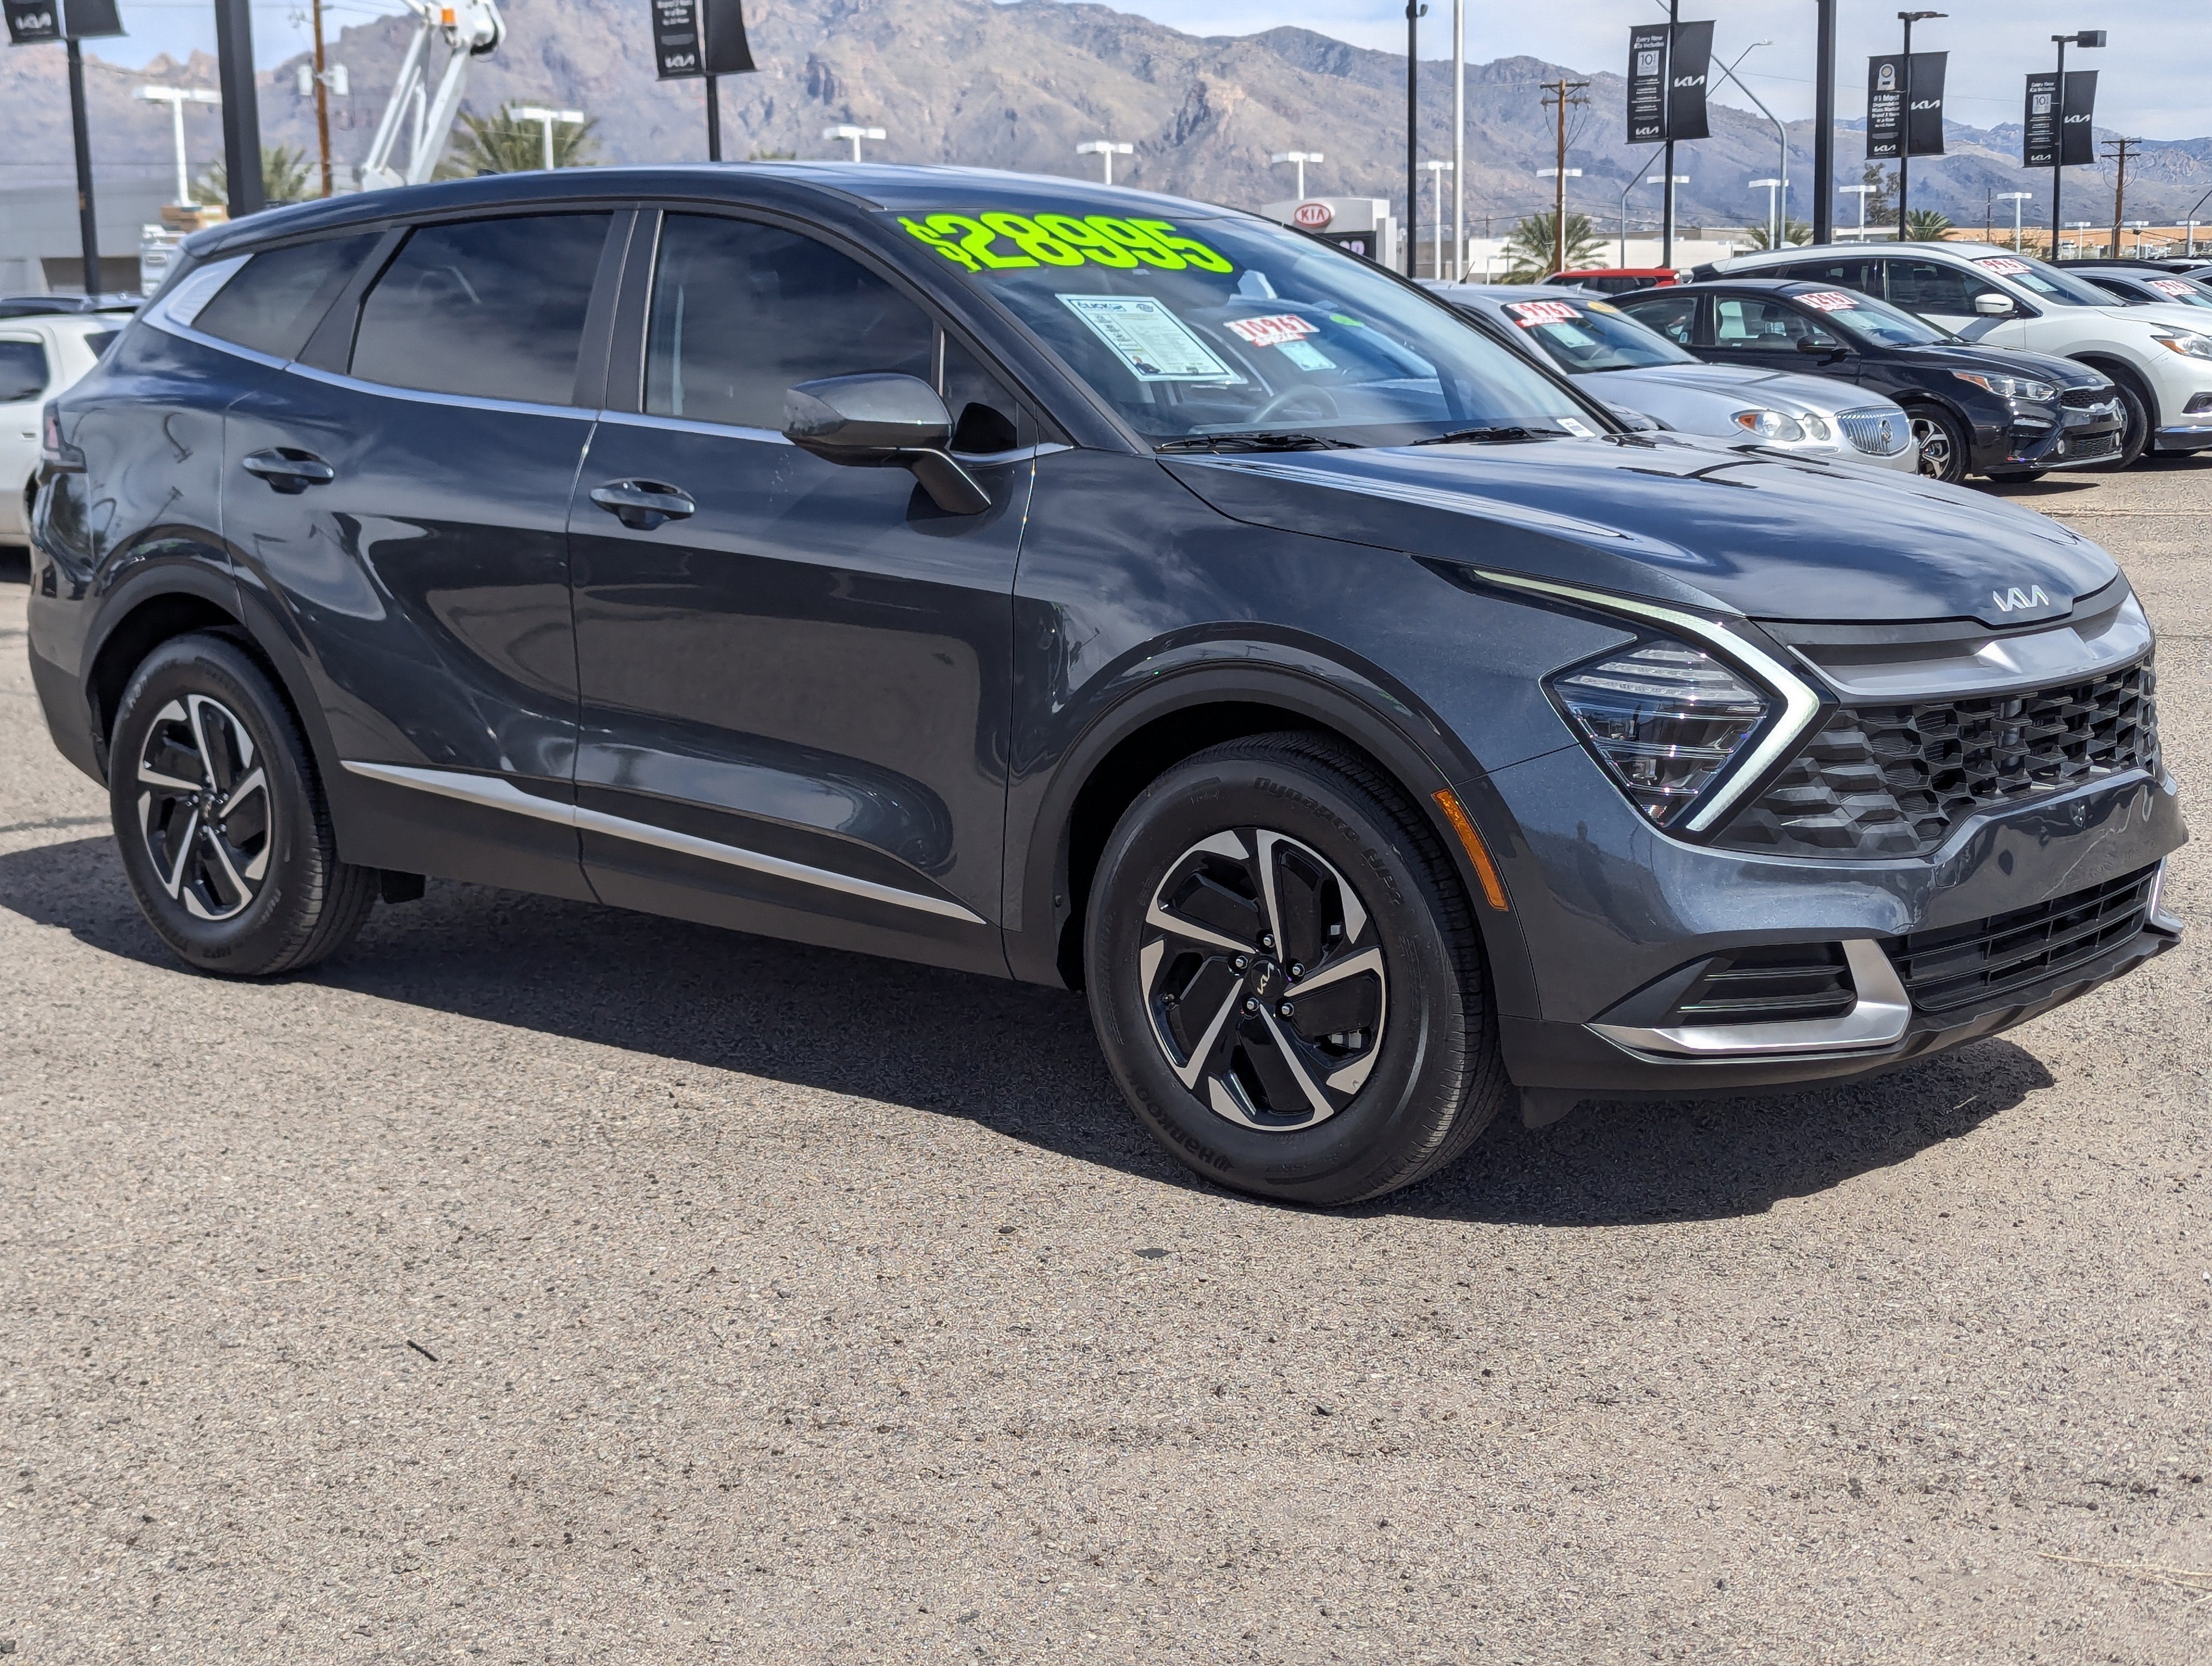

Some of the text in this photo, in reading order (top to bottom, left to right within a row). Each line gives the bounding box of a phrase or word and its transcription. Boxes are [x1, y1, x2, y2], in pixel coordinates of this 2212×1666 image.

[1674, 75, 1705, 87] KIA
[1911, 99, 1940, 110] KIA
[2064, 114, 2091, 123] KIA
[1636, 126, 1659, 135] KIA
[1874, 144, 1896, 152] KIA
[1301, 209, 1324, 221] KIA
[897, 212, 1233, 273] $28995
[1993, 585, 2049, 612] KIA
[1254, 777, 1360, 841] Dynapro
